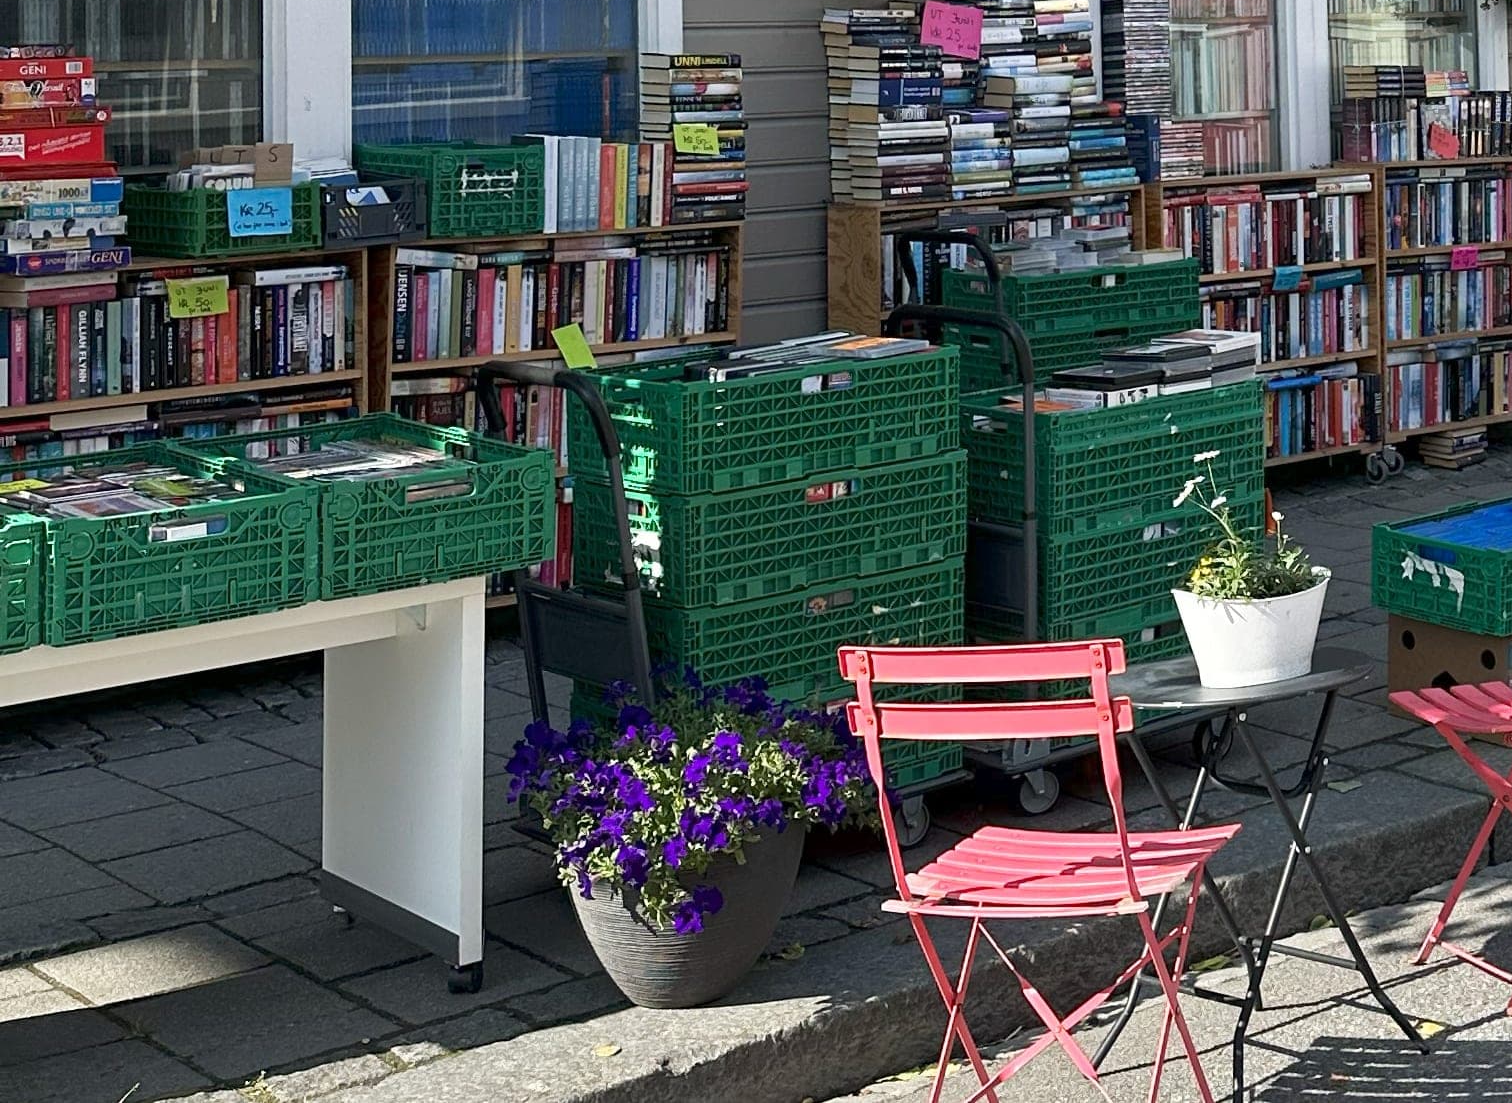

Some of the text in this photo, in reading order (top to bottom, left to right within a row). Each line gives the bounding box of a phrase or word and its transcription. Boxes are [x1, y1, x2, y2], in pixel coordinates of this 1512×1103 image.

[674, 56, 728, 67] UNNI LINDELL
[19, 65, 47, 75] GENI
[268, 146, 278, 163] S
[58, 187, 80, 198] 1000
[91, 251, 124, 264] GENI
[397, 271, 407, 312] JENSEN
[78, 310, 88, 384] GILLIAN FLYNN
